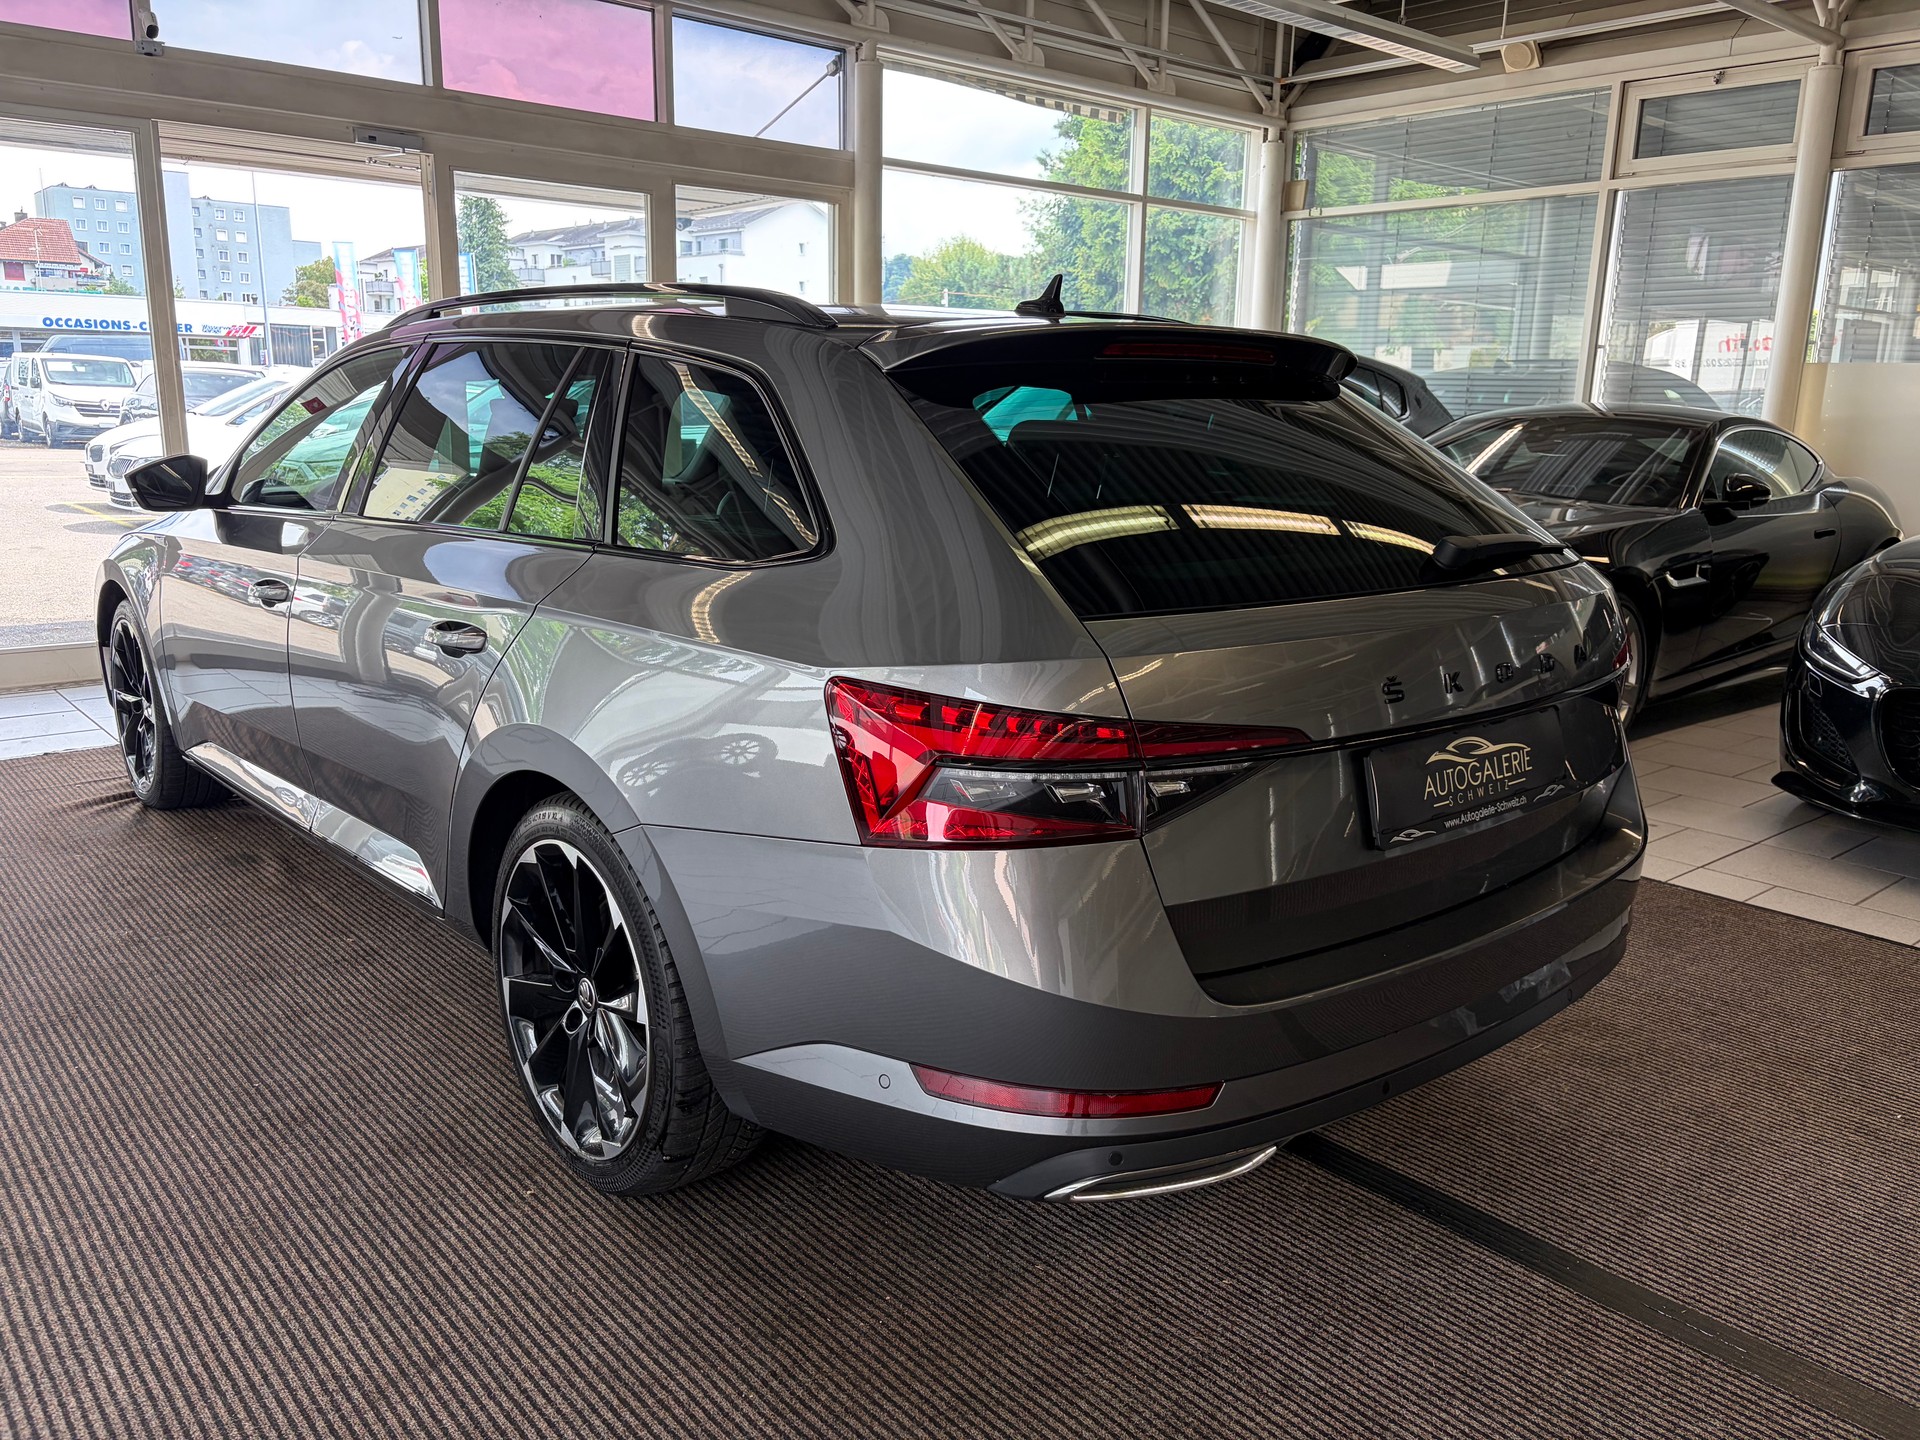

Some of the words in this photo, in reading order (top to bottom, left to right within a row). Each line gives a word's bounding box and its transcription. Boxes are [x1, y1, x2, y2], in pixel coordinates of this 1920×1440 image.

[42, 317, 193, 333] OCCASIONS-CER
[1424, 747, 1533, 801] AUTOGALERIE
[1448, 779, 1510, 807] SCHWEIZ
[1444, 795, 1528, 829] www.Autogalerie-Schweiz.ch
